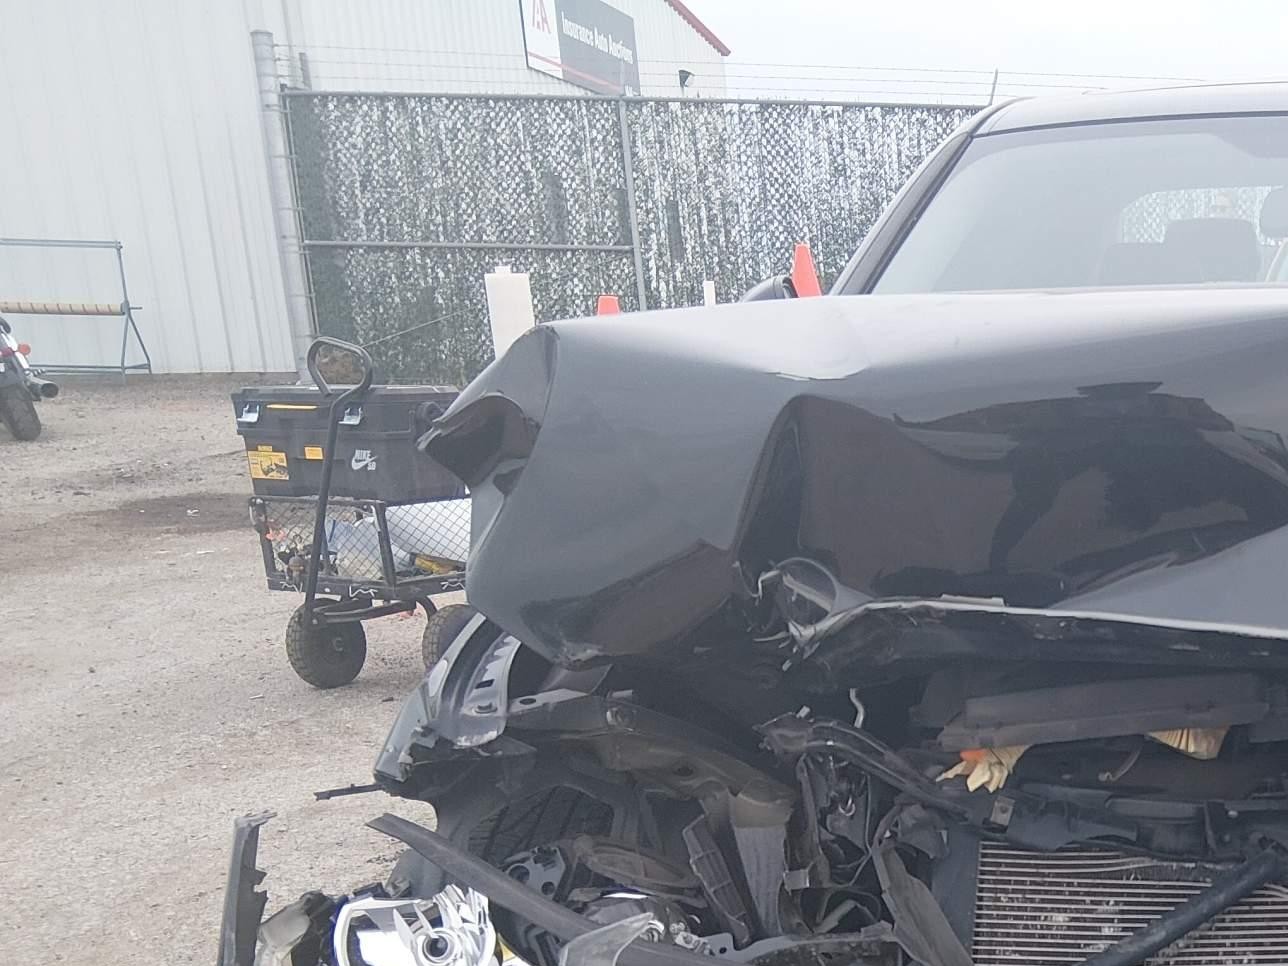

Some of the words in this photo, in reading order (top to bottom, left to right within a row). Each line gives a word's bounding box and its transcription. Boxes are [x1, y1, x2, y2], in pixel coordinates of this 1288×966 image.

[561, 10, 594, 47] Insurance
[594, 26, 609, 53] Auto
[608, 32, 634, 65] Auctions
[355, 449, 372, 460] NIKE
